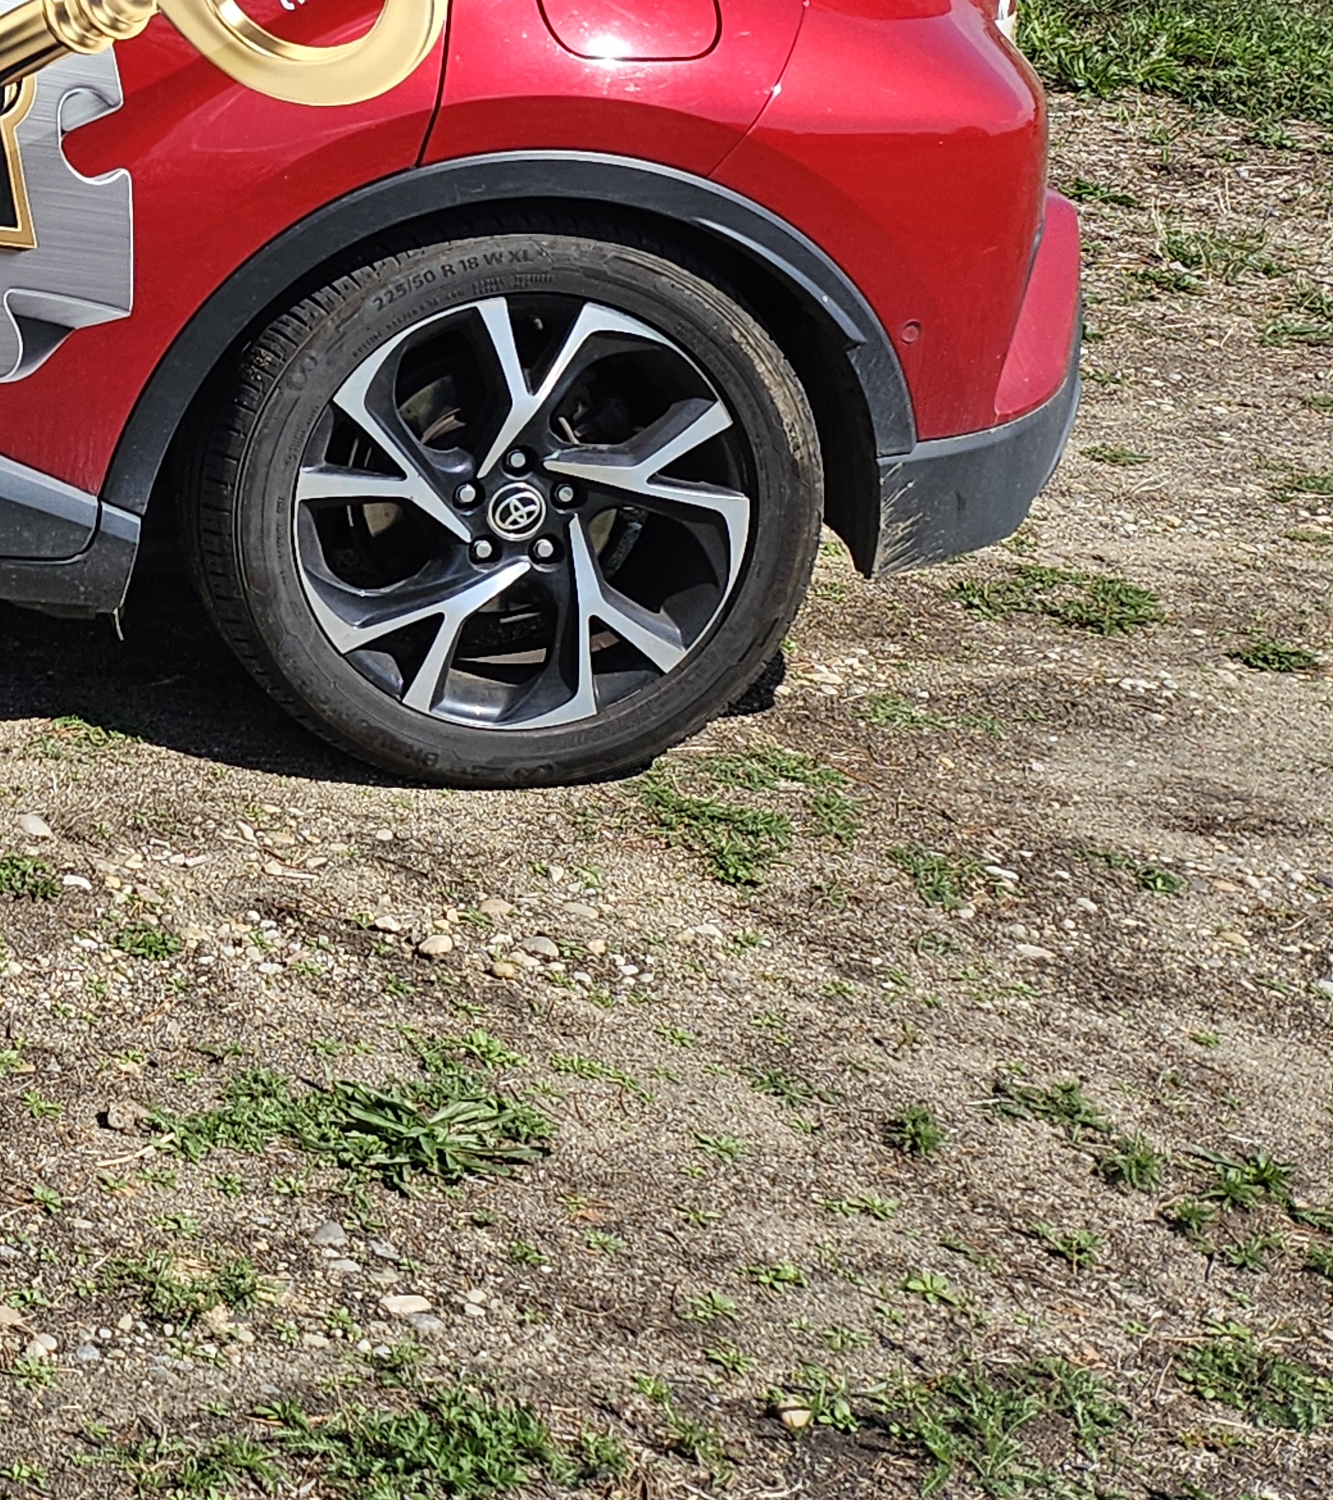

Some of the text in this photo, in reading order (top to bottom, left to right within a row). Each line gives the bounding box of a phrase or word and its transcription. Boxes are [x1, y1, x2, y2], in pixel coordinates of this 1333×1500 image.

[373, 270, 436, 311] 225/50
[440, 264, 457, 279] R
[458, 255, 480, 272] 18
